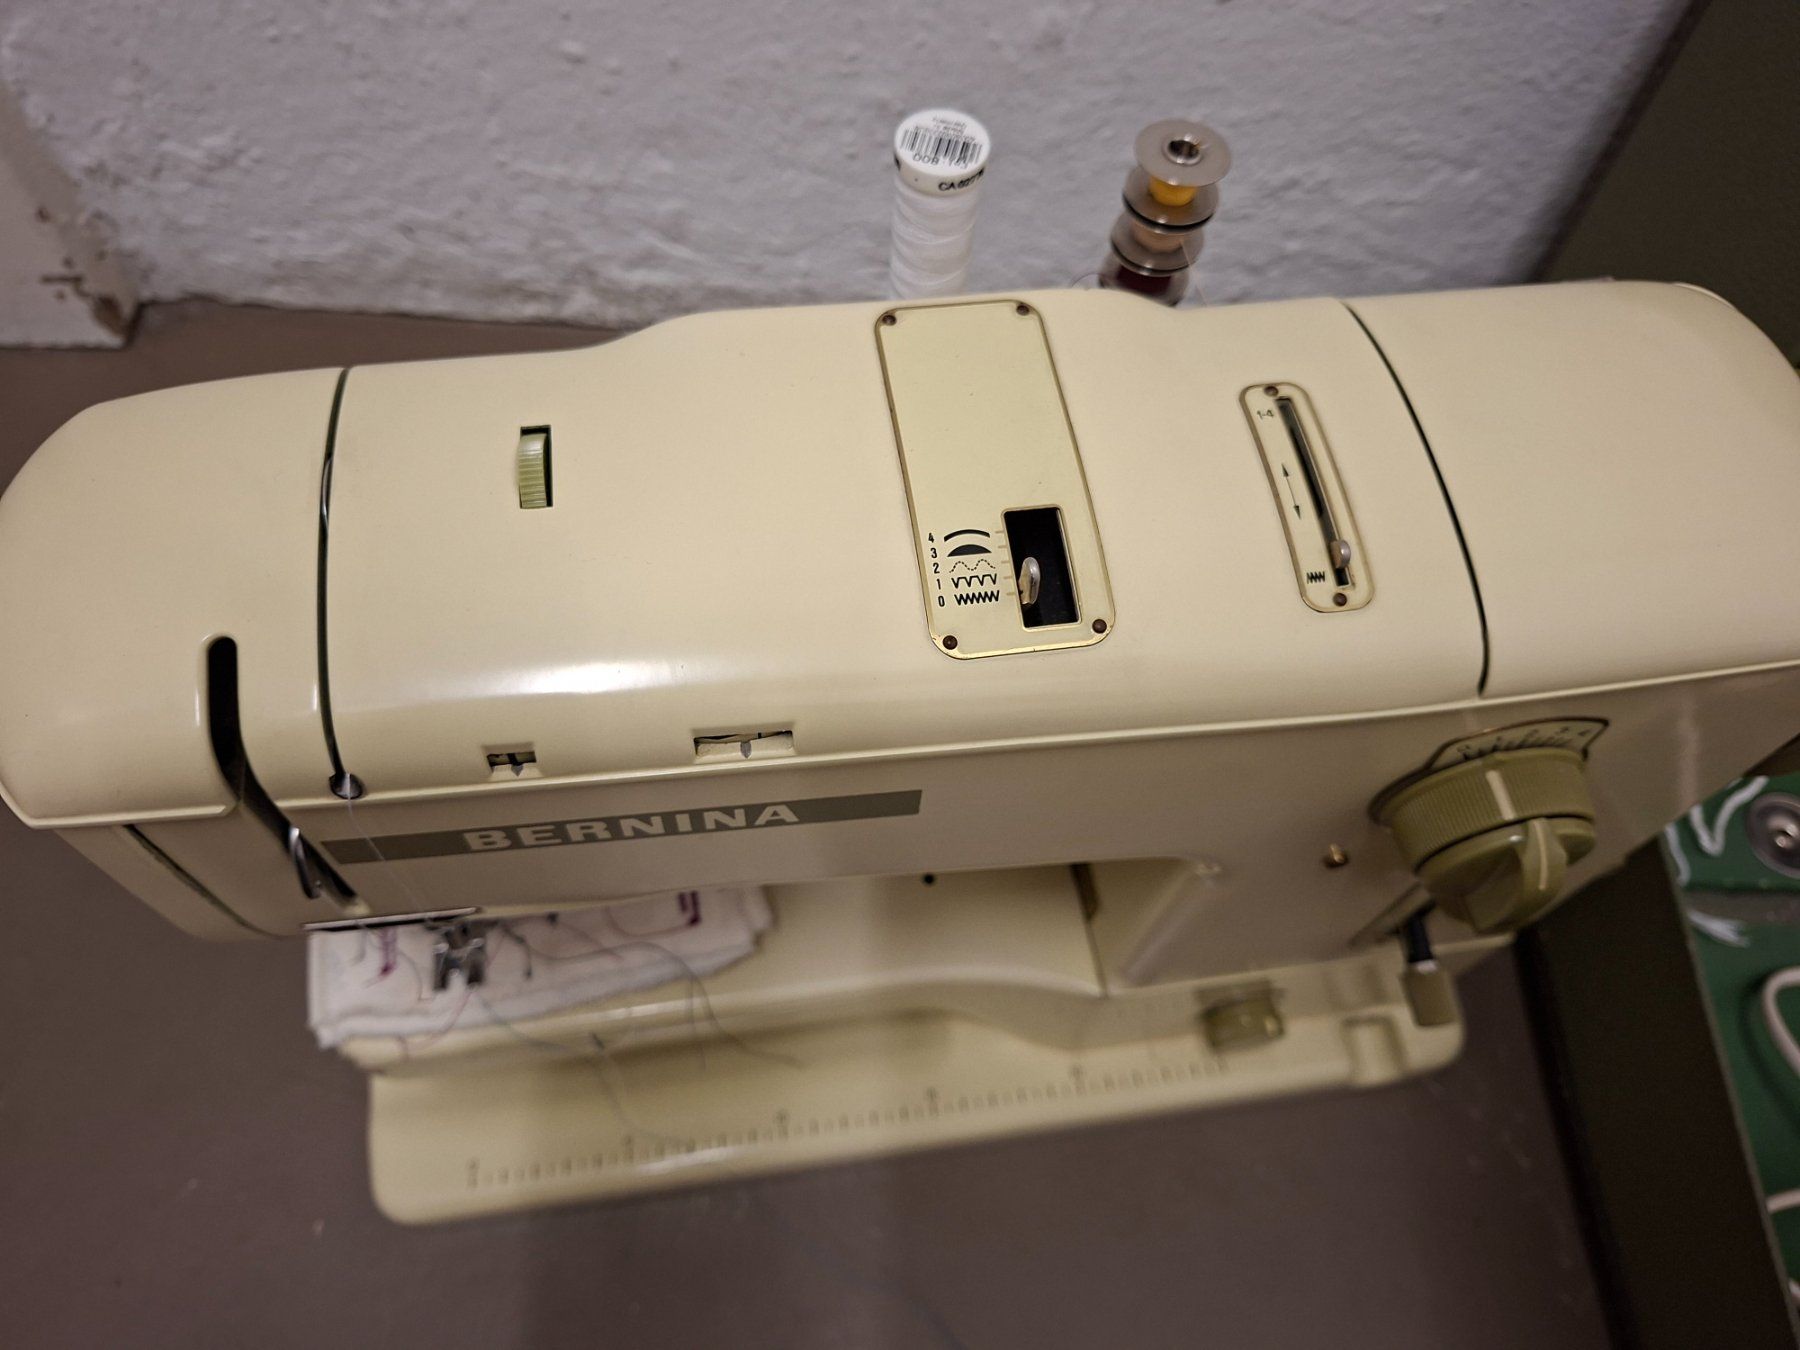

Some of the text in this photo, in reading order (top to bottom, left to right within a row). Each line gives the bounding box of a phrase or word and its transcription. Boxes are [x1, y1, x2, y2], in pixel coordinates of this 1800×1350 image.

[928, 532, 935, 543] 4
[930, 547, 938, 558] 3
[932, 562, 940, 574] 2
[936, 578, 942, 590] 1
[938, 595, 946, 607] 0
[463, 803, 800, 851] BERNINA
